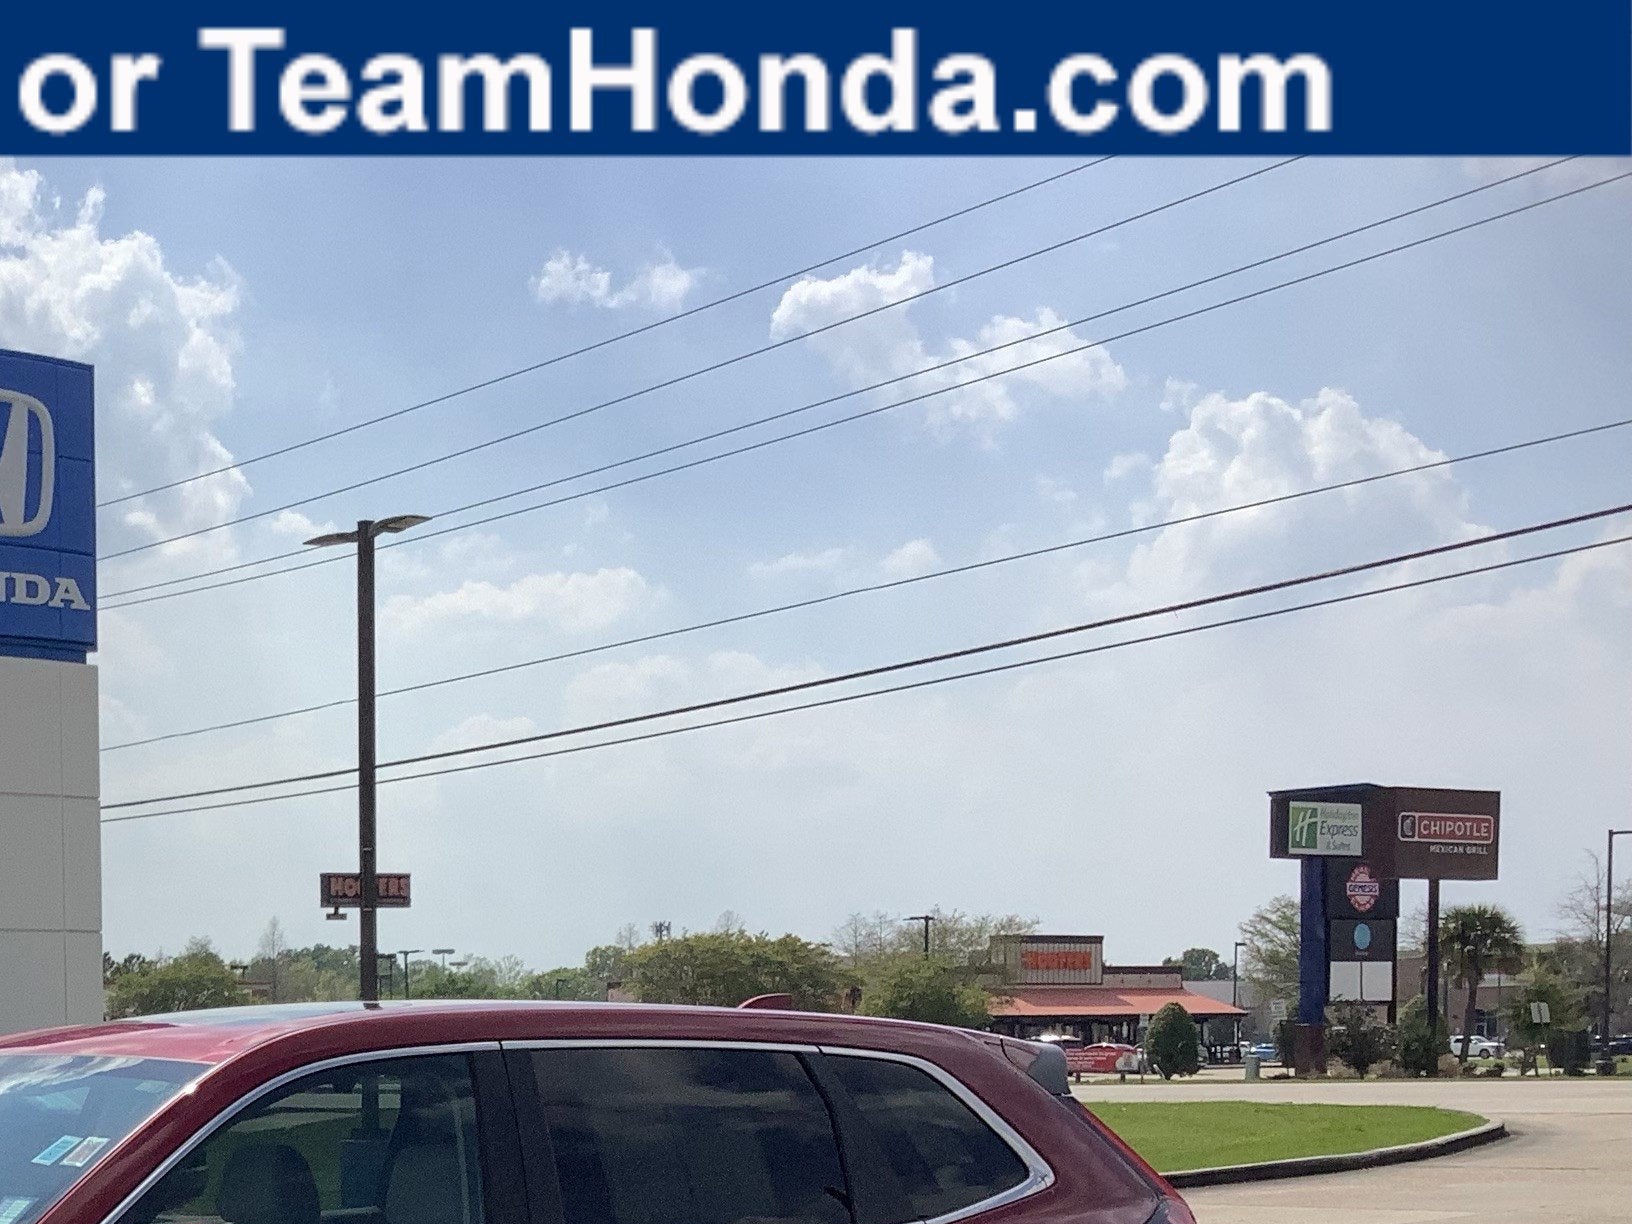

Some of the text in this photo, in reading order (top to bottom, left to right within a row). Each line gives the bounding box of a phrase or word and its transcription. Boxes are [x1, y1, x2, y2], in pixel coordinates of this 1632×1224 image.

[1319, 820, 1359, 840] Express
[1420, 819, 1490, 839] CHIPOTLE
[1429, 844, 1489, 856] MEXICAN GRILL
[329, 876, 409, 897] HOERS
[1348, 883, 1378, 894] GENESIS
